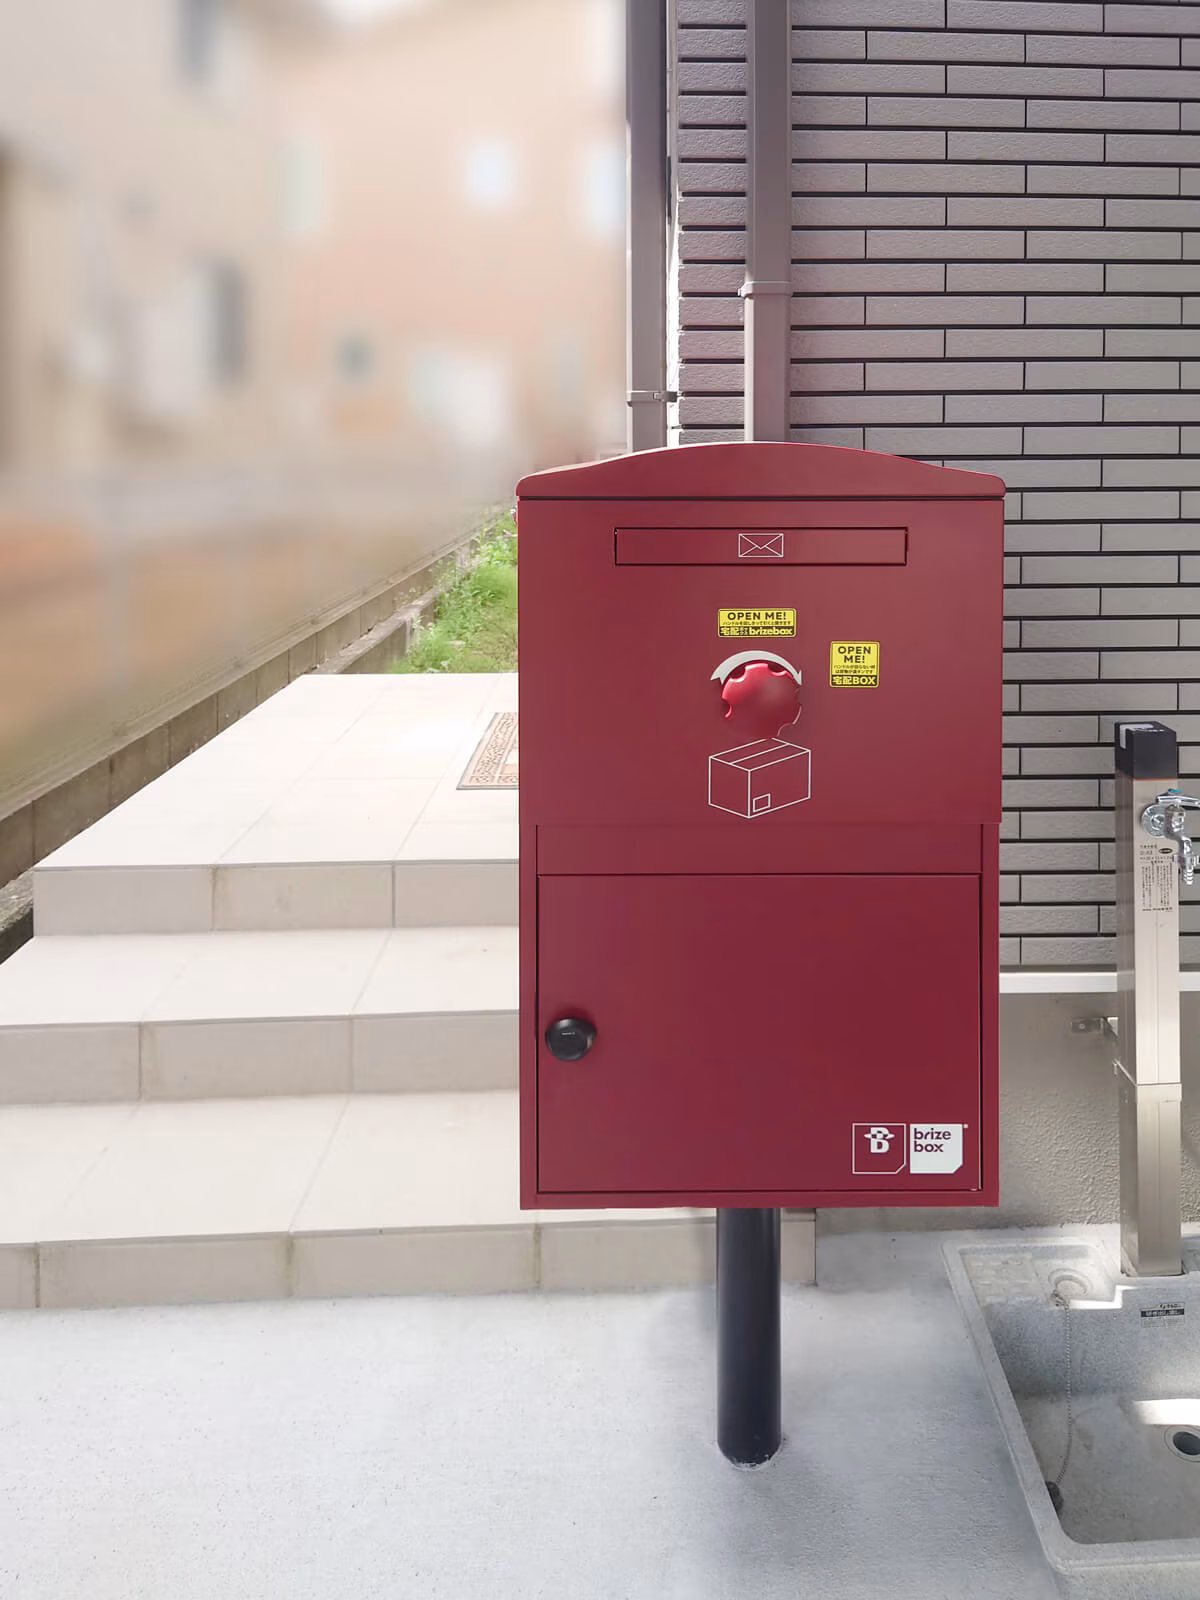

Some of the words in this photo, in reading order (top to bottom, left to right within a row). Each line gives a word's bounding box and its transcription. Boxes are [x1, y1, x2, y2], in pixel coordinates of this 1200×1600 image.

[727, 612, 761, 621] OPEN
[765, 612, 786, 620] ME!
[749, 626, 793, 635] brizebox
[837, 646, 871, 654] OPEN
[843, 655, 865, 663] ME!
[913, 1127, 952, 1140] brize
[913, 1140, 944, 1152] box
